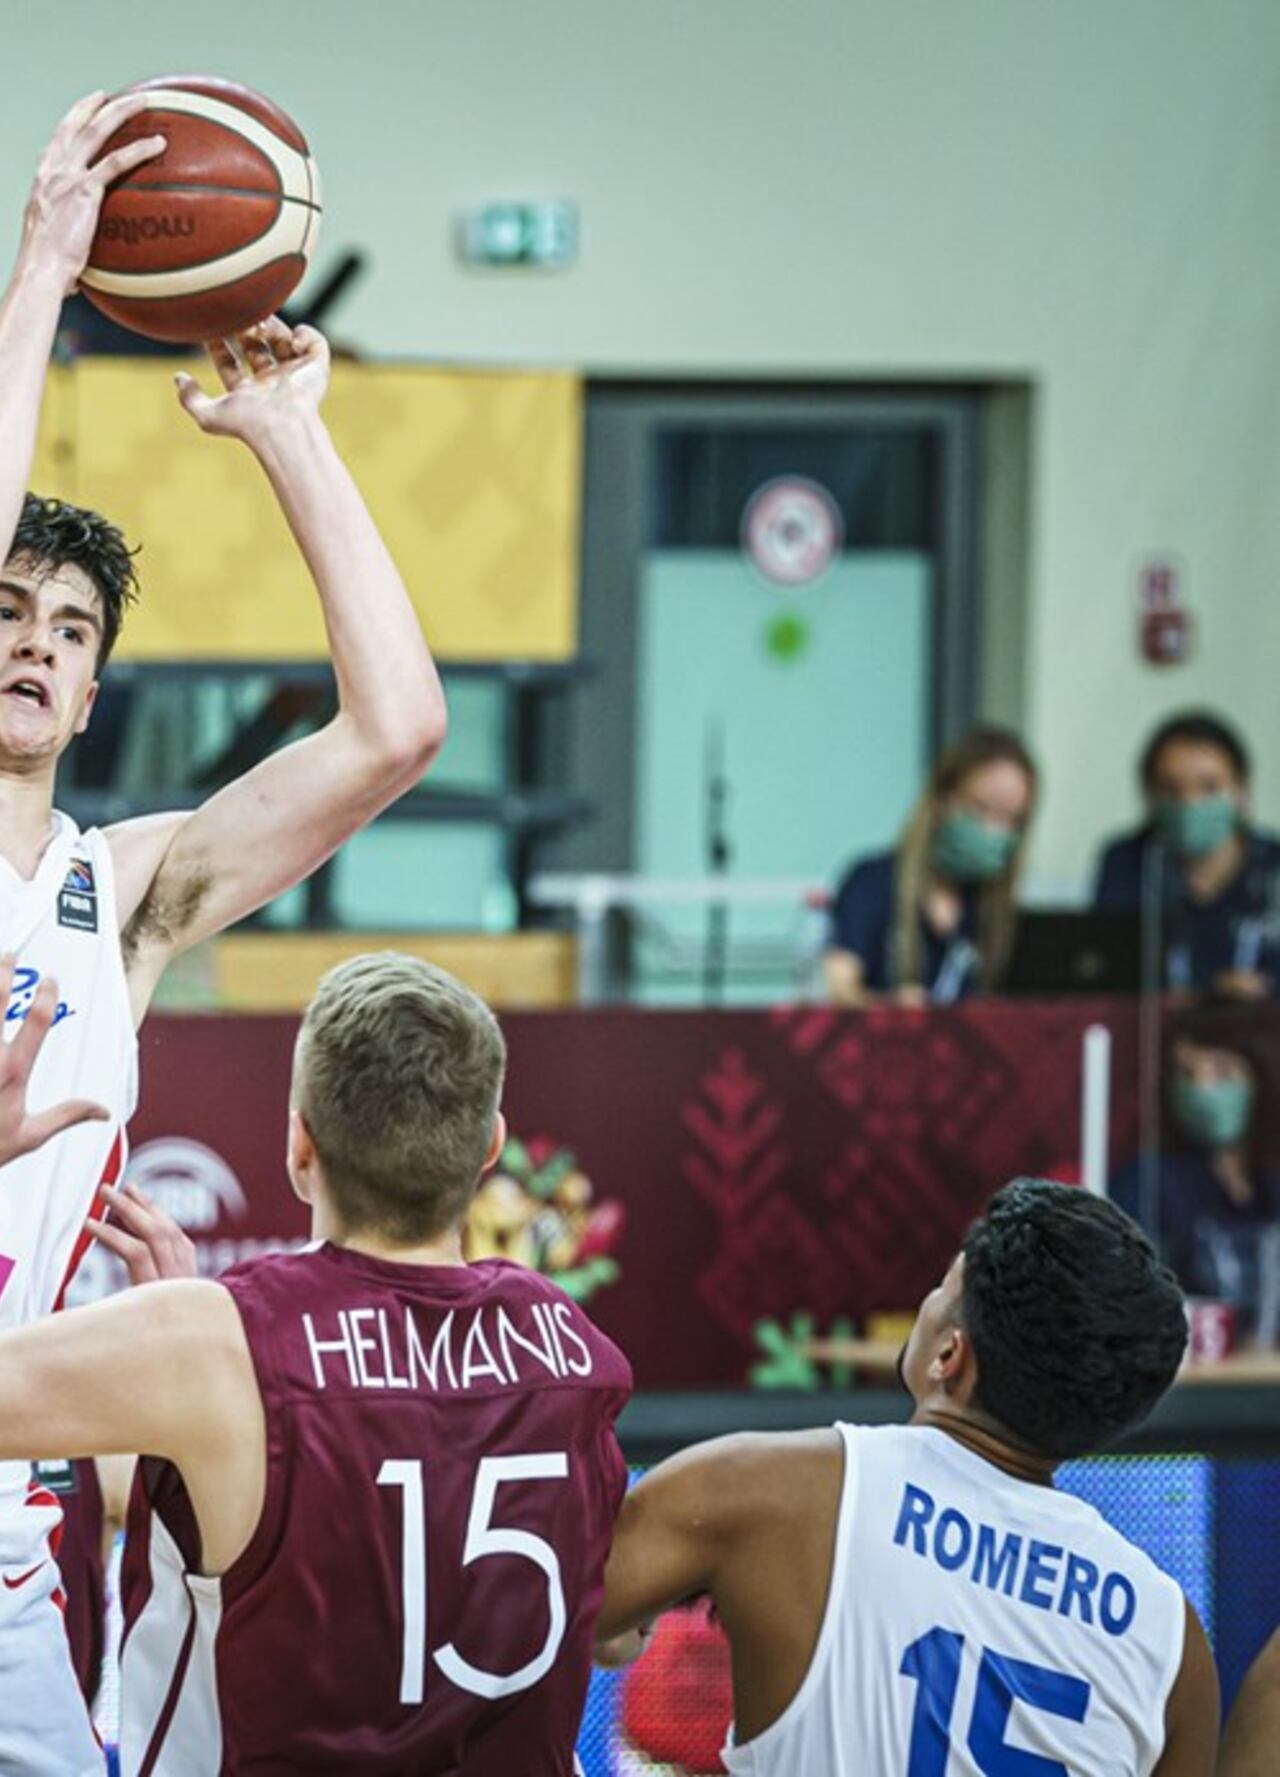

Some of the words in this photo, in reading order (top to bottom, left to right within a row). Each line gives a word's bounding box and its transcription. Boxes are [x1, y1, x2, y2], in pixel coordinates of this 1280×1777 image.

[100, 214, 196, 246] molte
[301, 1302, 593, 1391] HELMANIS
[375, 1451, 569, 1705] 15
[892, 1481, 1136, 1637] ROMERO
[898, 1624, 1092, 1777] 15
